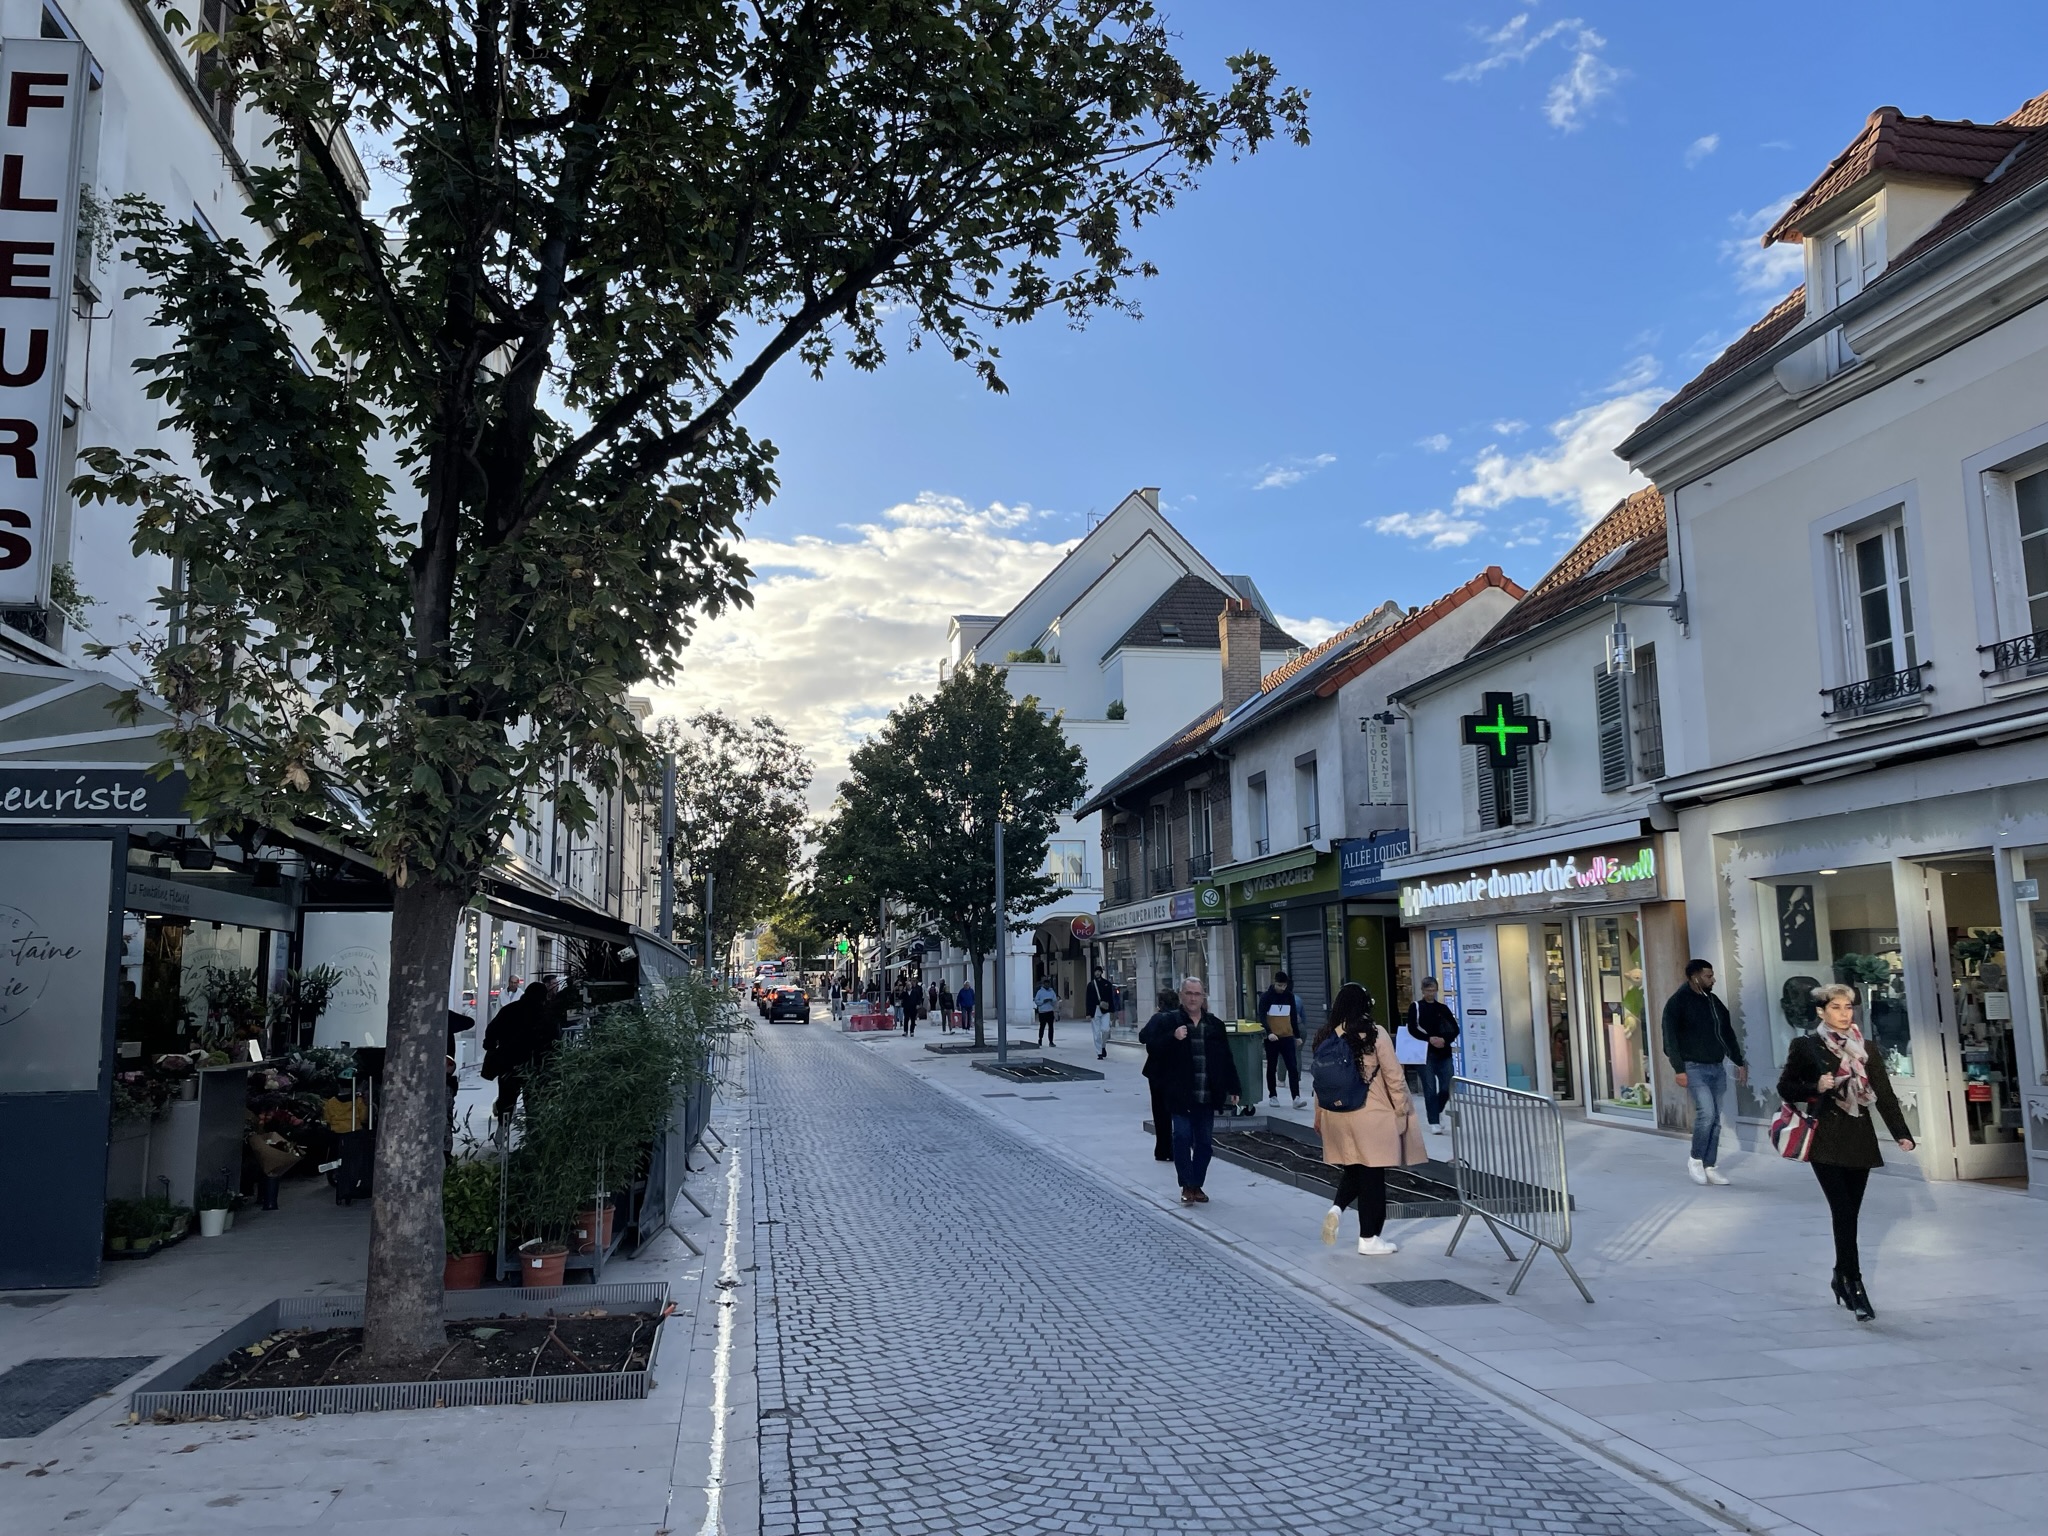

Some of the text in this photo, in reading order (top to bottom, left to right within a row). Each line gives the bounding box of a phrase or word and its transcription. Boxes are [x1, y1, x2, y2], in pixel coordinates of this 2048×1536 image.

[0, 71, 69, 570] FLEURS
[1380, 727, 1390, 787] BROCANTE
[0, 775, 147, 811] euriste
[1343, 841, 1407, 869] ALLÉE LOUISE
[1254, 867, 1314, 891] YVES ROCHER
